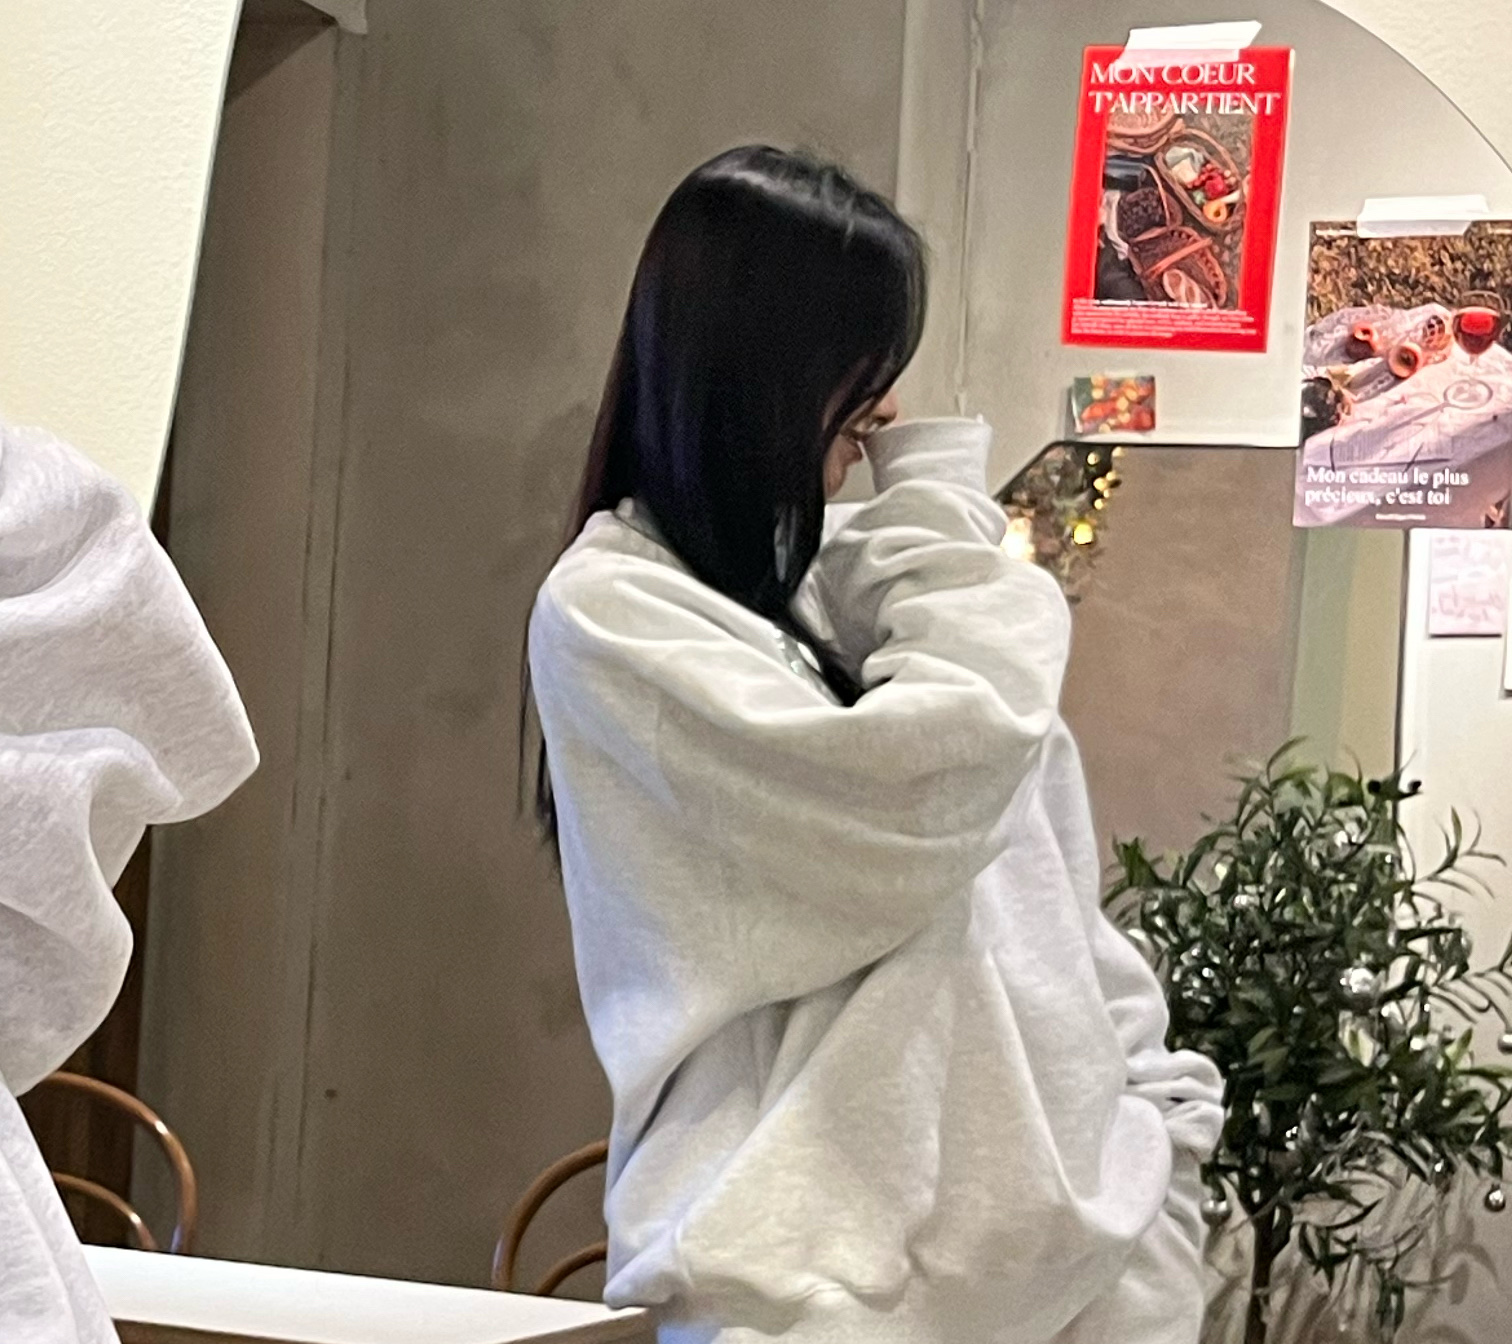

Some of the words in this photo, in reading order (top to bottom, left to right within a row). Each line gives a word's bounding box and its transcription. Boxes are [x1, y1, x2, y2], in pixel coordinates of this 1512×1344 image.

[1090, 62, 1154, 85] MON
[1161, 62, 1256, 85] COEUR
[1087, 90, 1282, 116] T'APPARTIENT
[1306, 466, 1346, 484] Mon
[1349, 467, 1409, 485] cadeau
[1413, 467, 1429, 485] le
[1432, 468, 1470, 489] plus
[1385, 487, 1425, 505] c'est
[1427, 487, 1451, 505] toi
